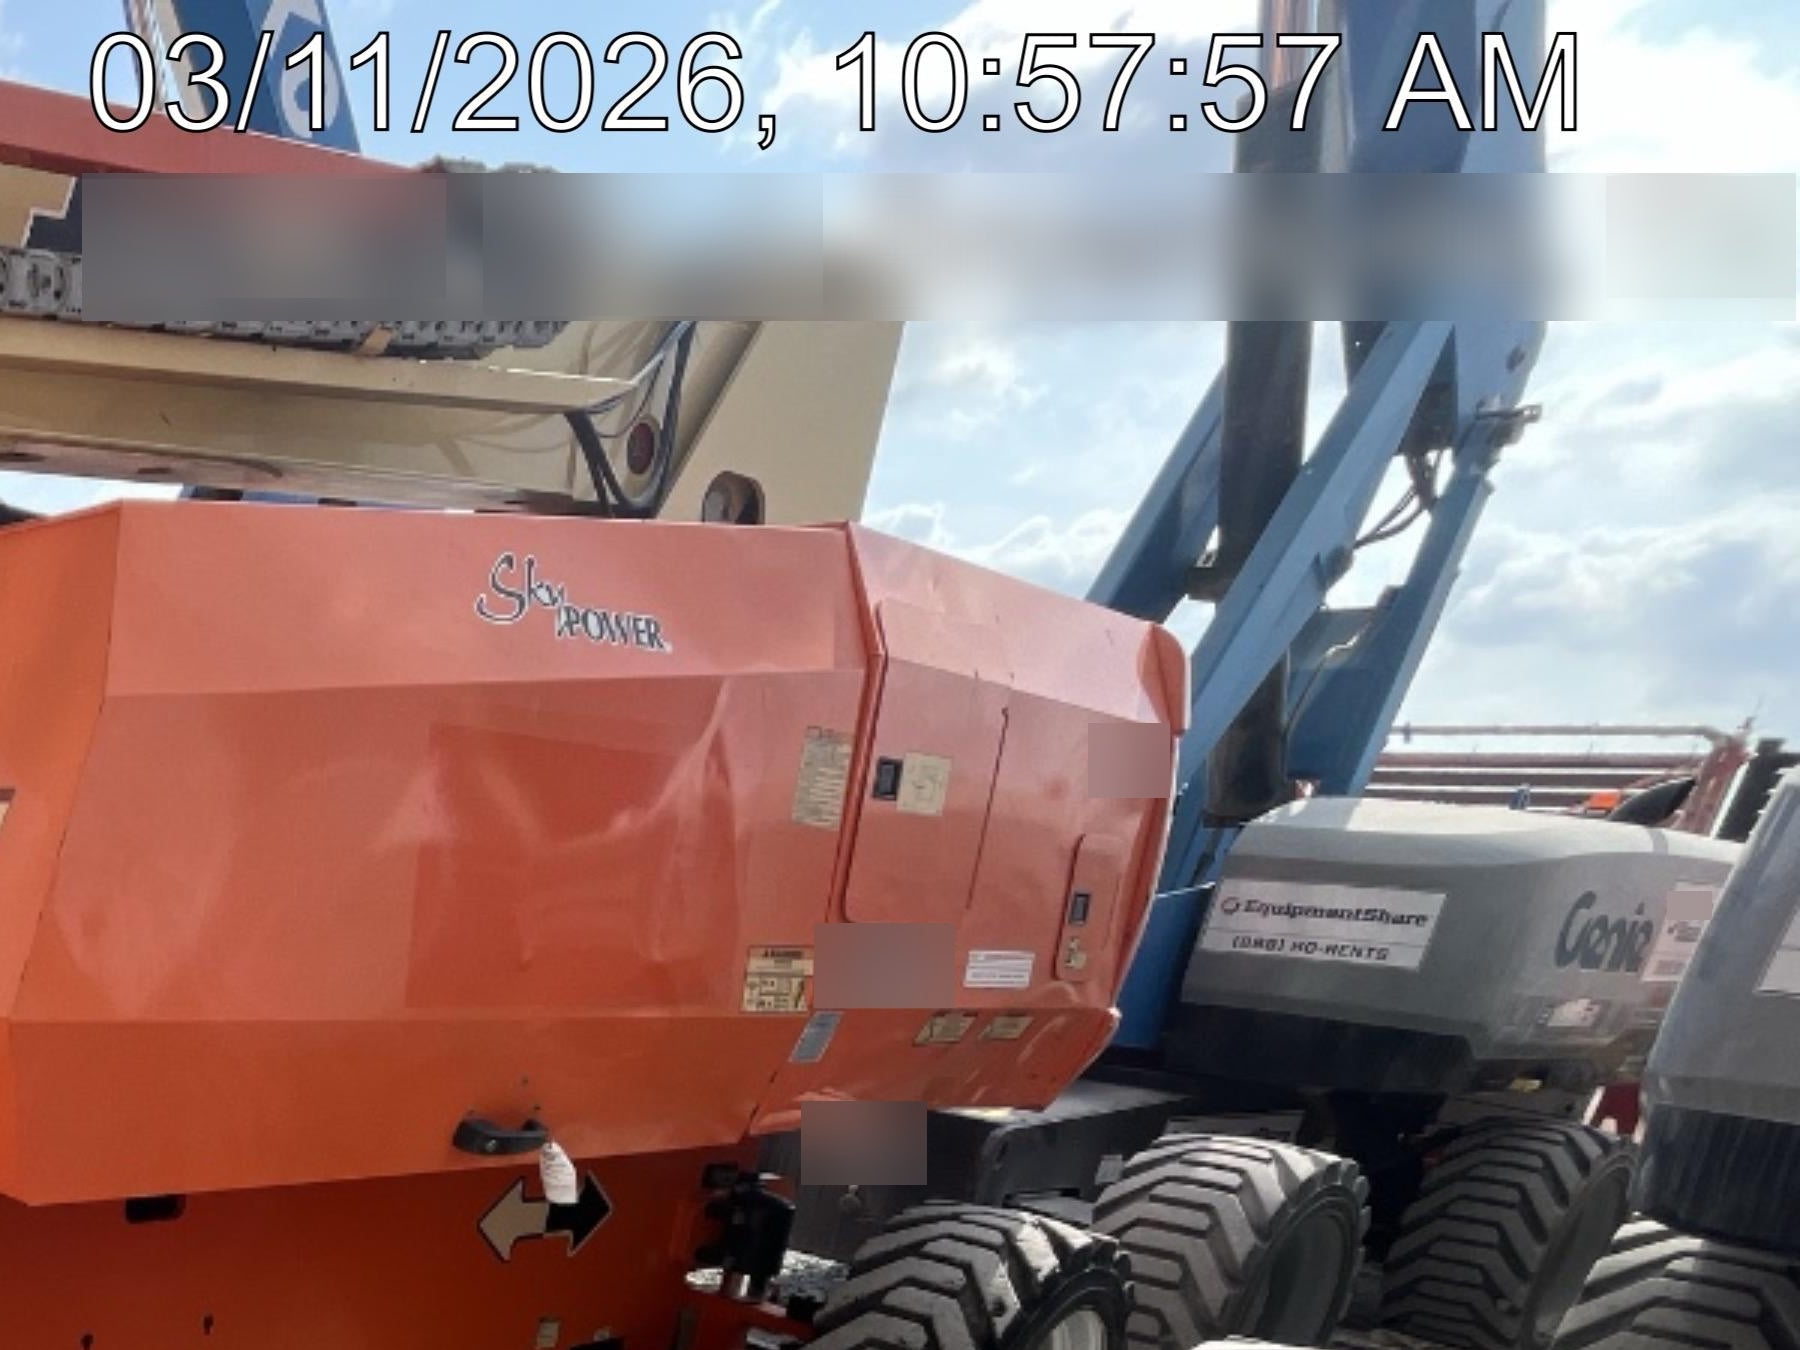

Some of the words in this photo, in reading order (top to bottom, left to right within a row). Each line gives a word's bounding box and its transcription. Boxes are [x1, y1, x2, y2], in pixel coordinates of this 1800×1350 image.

[475, 552, 568, 637] Sky
[560, 604, 667, 650] POWER
[1244, 898, 1429, 928] EquipmentShare
[1554, 889, 1653, 973] Genie
